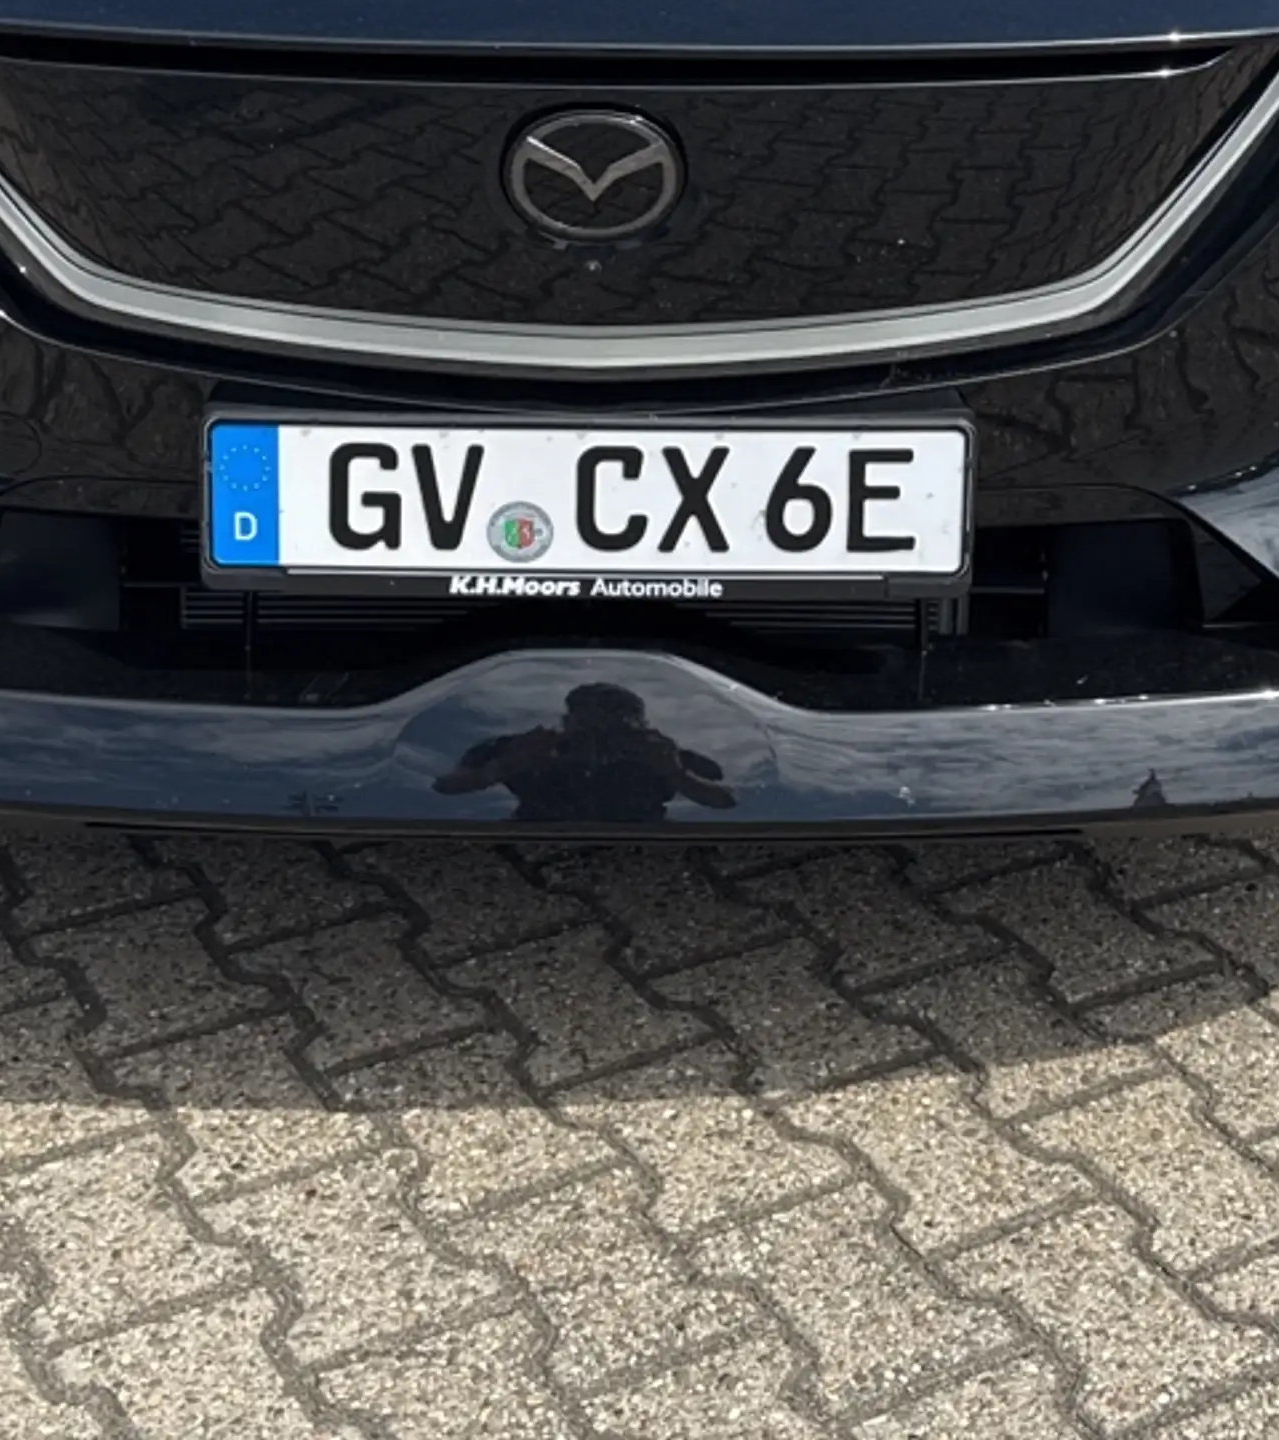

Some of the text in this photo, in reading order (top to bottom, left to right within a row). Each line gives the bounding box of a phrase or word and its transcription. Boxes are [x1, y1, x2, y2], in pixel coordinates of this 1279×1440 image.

[234, 511, 257, 541] D
[328, 442, 485, 551] GV
[575, 446, 730, 553] CX
[764, 446, 917, 553] 6E
[589, 578, 723, 598] Automobile
